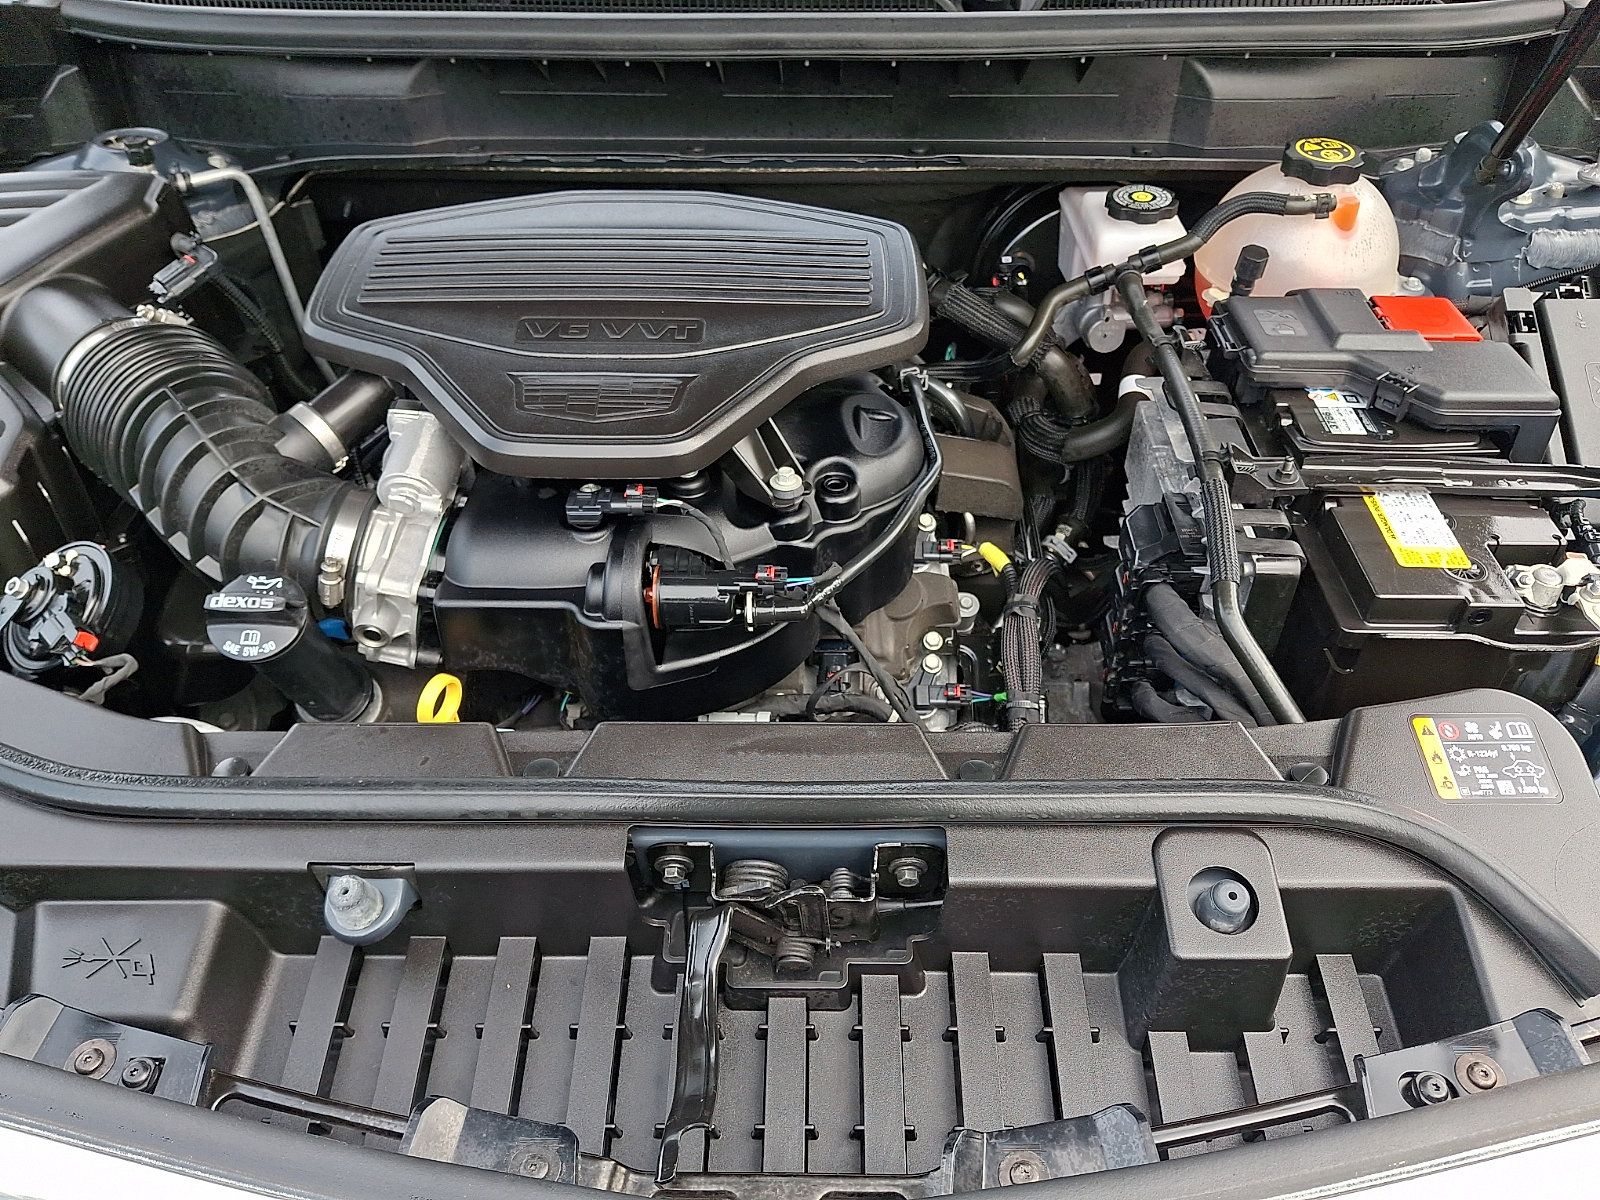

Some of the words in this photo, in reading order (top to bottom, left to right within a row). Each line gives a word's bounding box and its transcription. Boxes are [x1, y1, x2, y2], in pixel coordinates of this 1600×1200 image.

[525, 321, 590, 340] V6
[600, 321, 698, 340] VVT
[209, 593, 276, 609] dexos
[222, 640, 241, 656] SAE
[242, 640, 276, 657] 5W-30
